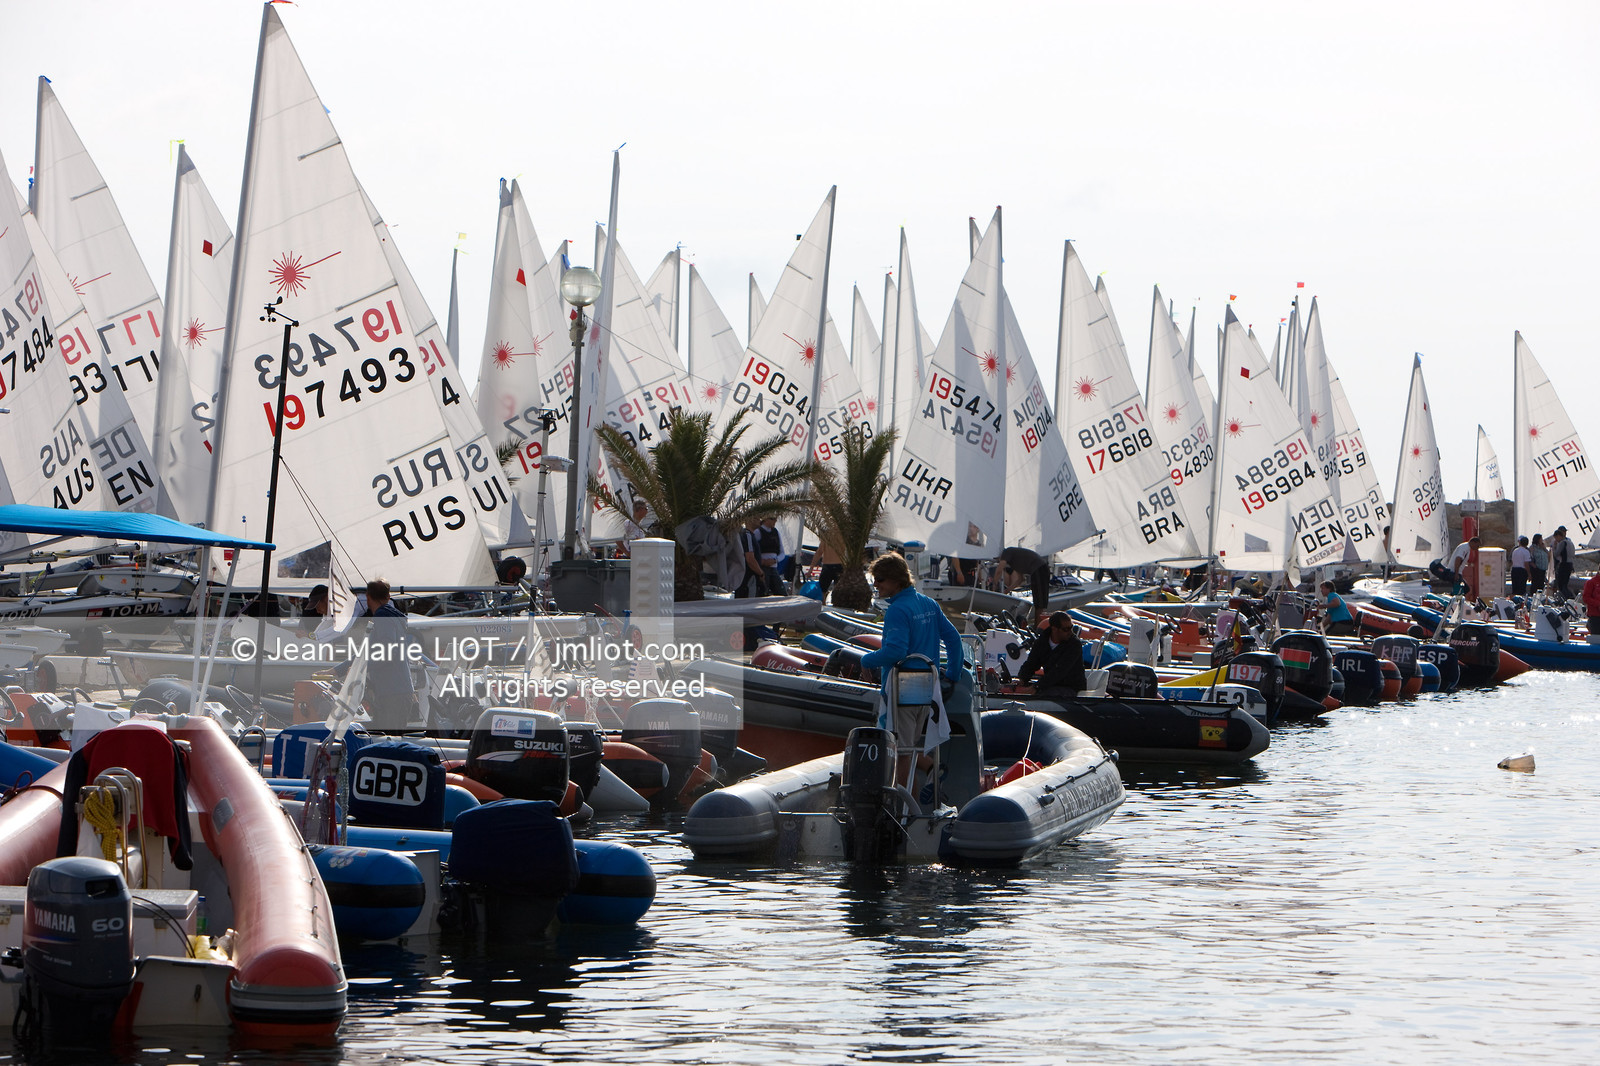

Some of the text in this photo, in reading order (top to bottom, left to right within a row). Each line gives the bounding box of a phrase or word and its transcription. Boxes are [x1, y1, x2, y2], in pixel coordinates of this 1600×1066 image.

[263, 347, 416, 438] 197493
[929, 373, 1002, 433] 195474
[1022, 406, 1052, 453] 181014
[1086, 428, 1153, 474] 176618
[902, 458, 953, 499] UKR
[1241, 461, 1316, 514] 196984
[1541, 455, 1587, 487] 197711
[1058, 483, 1083, 523] GRE
[382, 495, 466, 557] RUS
[1141, 511, 1185, 544] BRA
[1301, 520, 1346, 553] DEN
[109, 603, 159, 617] TORM
[1232, 665, 1261, 681] 197
[1341, 659, 1366, 672] IRL
[1418, 650, 1448, 664] ESP
[514, 740, 564, 751] SUZUKI
[858, 744, 880, 761] 70
[356, 761, 423, 801] GBR
[34, 908, 76, 933] YAMAHA
[91, 917, 125, 932] 60
